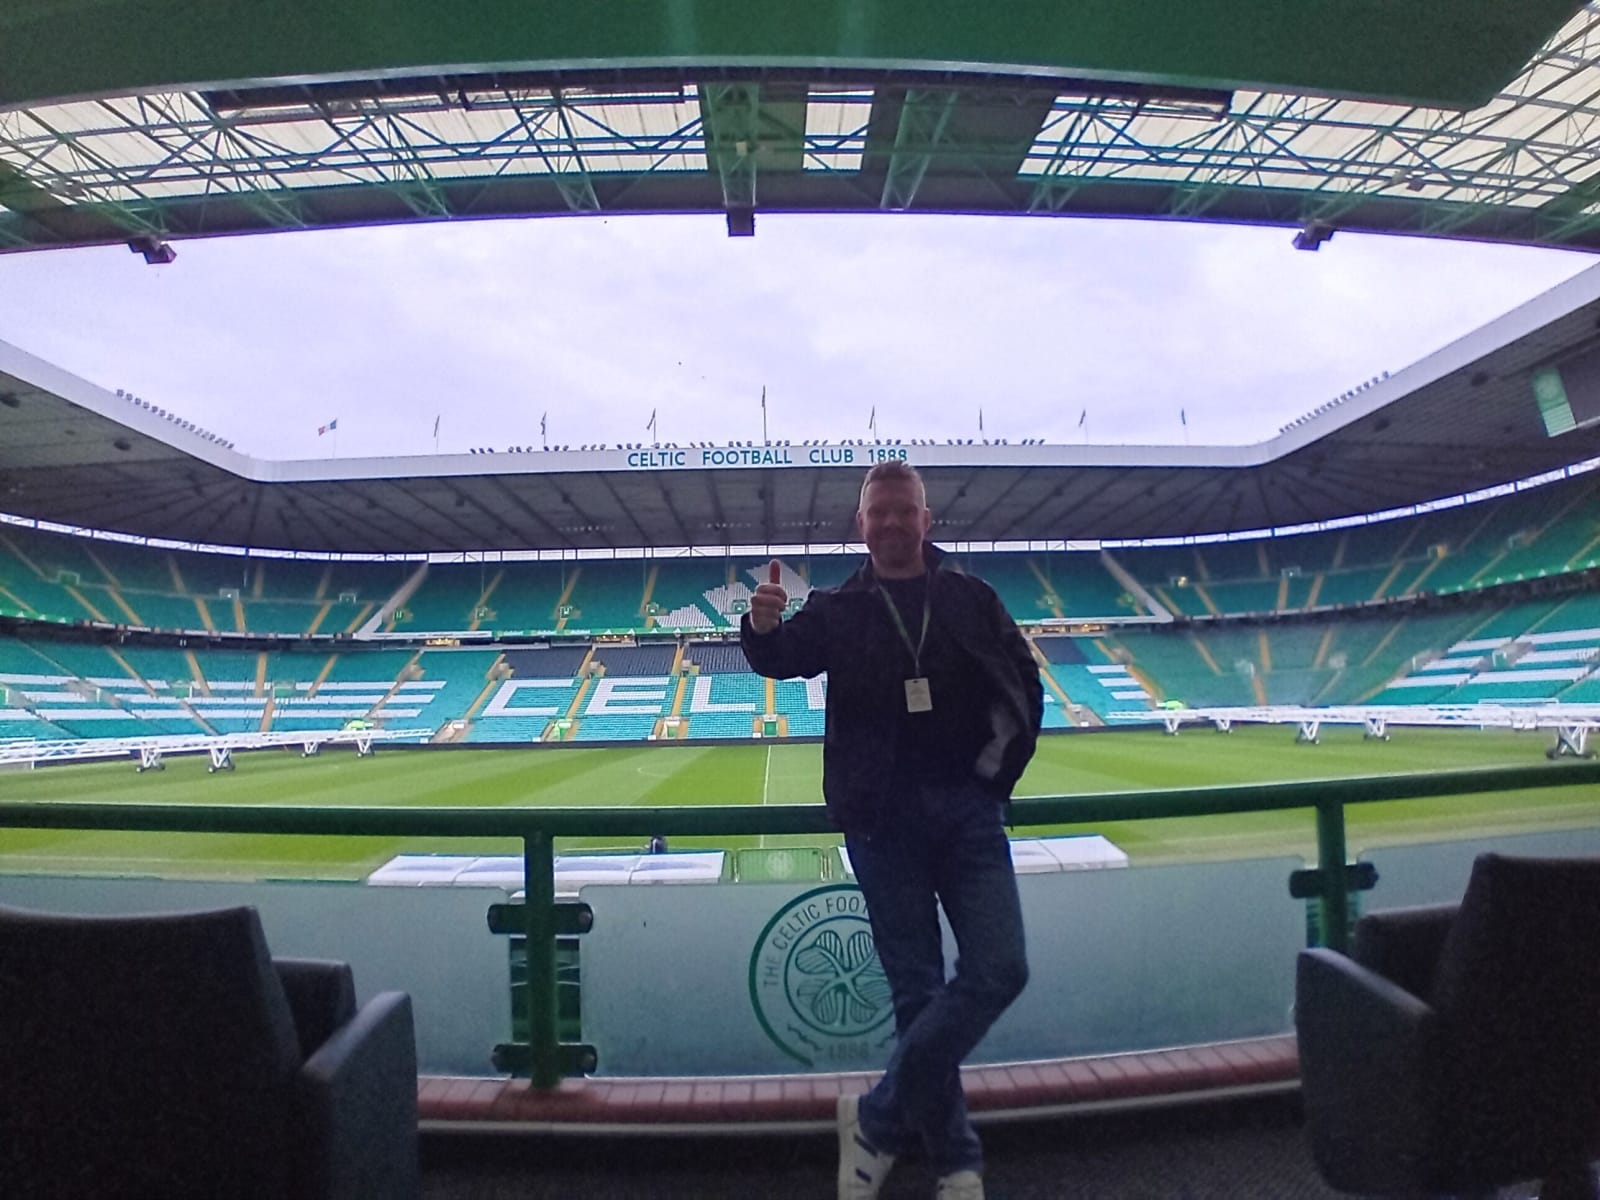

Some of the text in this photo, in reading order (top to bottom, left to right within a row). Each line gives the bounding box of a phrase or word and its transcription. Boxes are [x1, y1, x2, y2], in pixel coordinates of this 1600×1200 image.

[627, 448, 907, 467] CELTIC FOOTBALL CLUB 1888
[482, 676, 828, 717] CELT
[763, 896, 868, 990] THE CELTIC FOO
